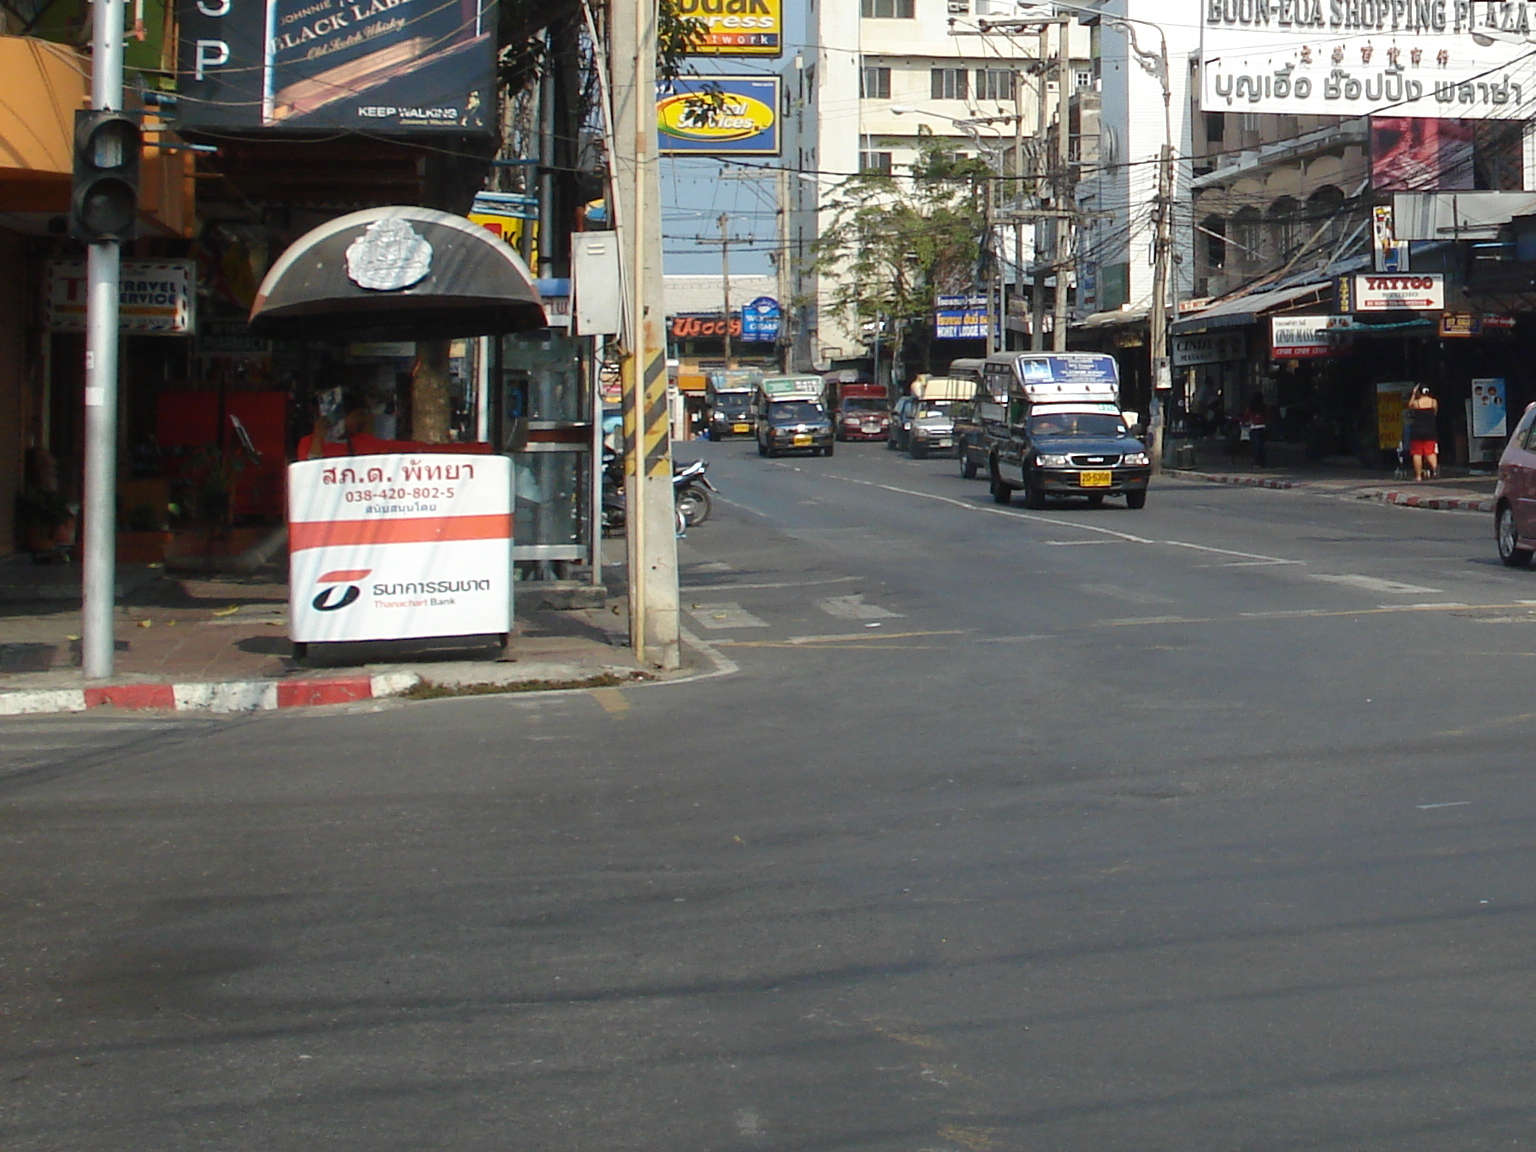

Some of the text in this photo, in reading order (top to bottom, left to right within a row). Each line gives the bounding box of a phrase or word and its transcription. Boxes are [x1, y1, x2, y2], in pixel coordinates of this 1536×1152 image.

[1453, 1, 1531, 32] PLAZA
[692, 34, 769, 46] twork
[195, 39, 230, 81] P
[358, 105, 459, 120] KEEP WALKING
[119, 293, 177, 305] ERVICE
[402, 459, 476, 483] พัทยา
[345, 487, 455, 503] 038-420-802-5
[372, 579, 490, 597] ธนาคารธนชาต
[374, 597, 457, 609] Thanachart Bank
